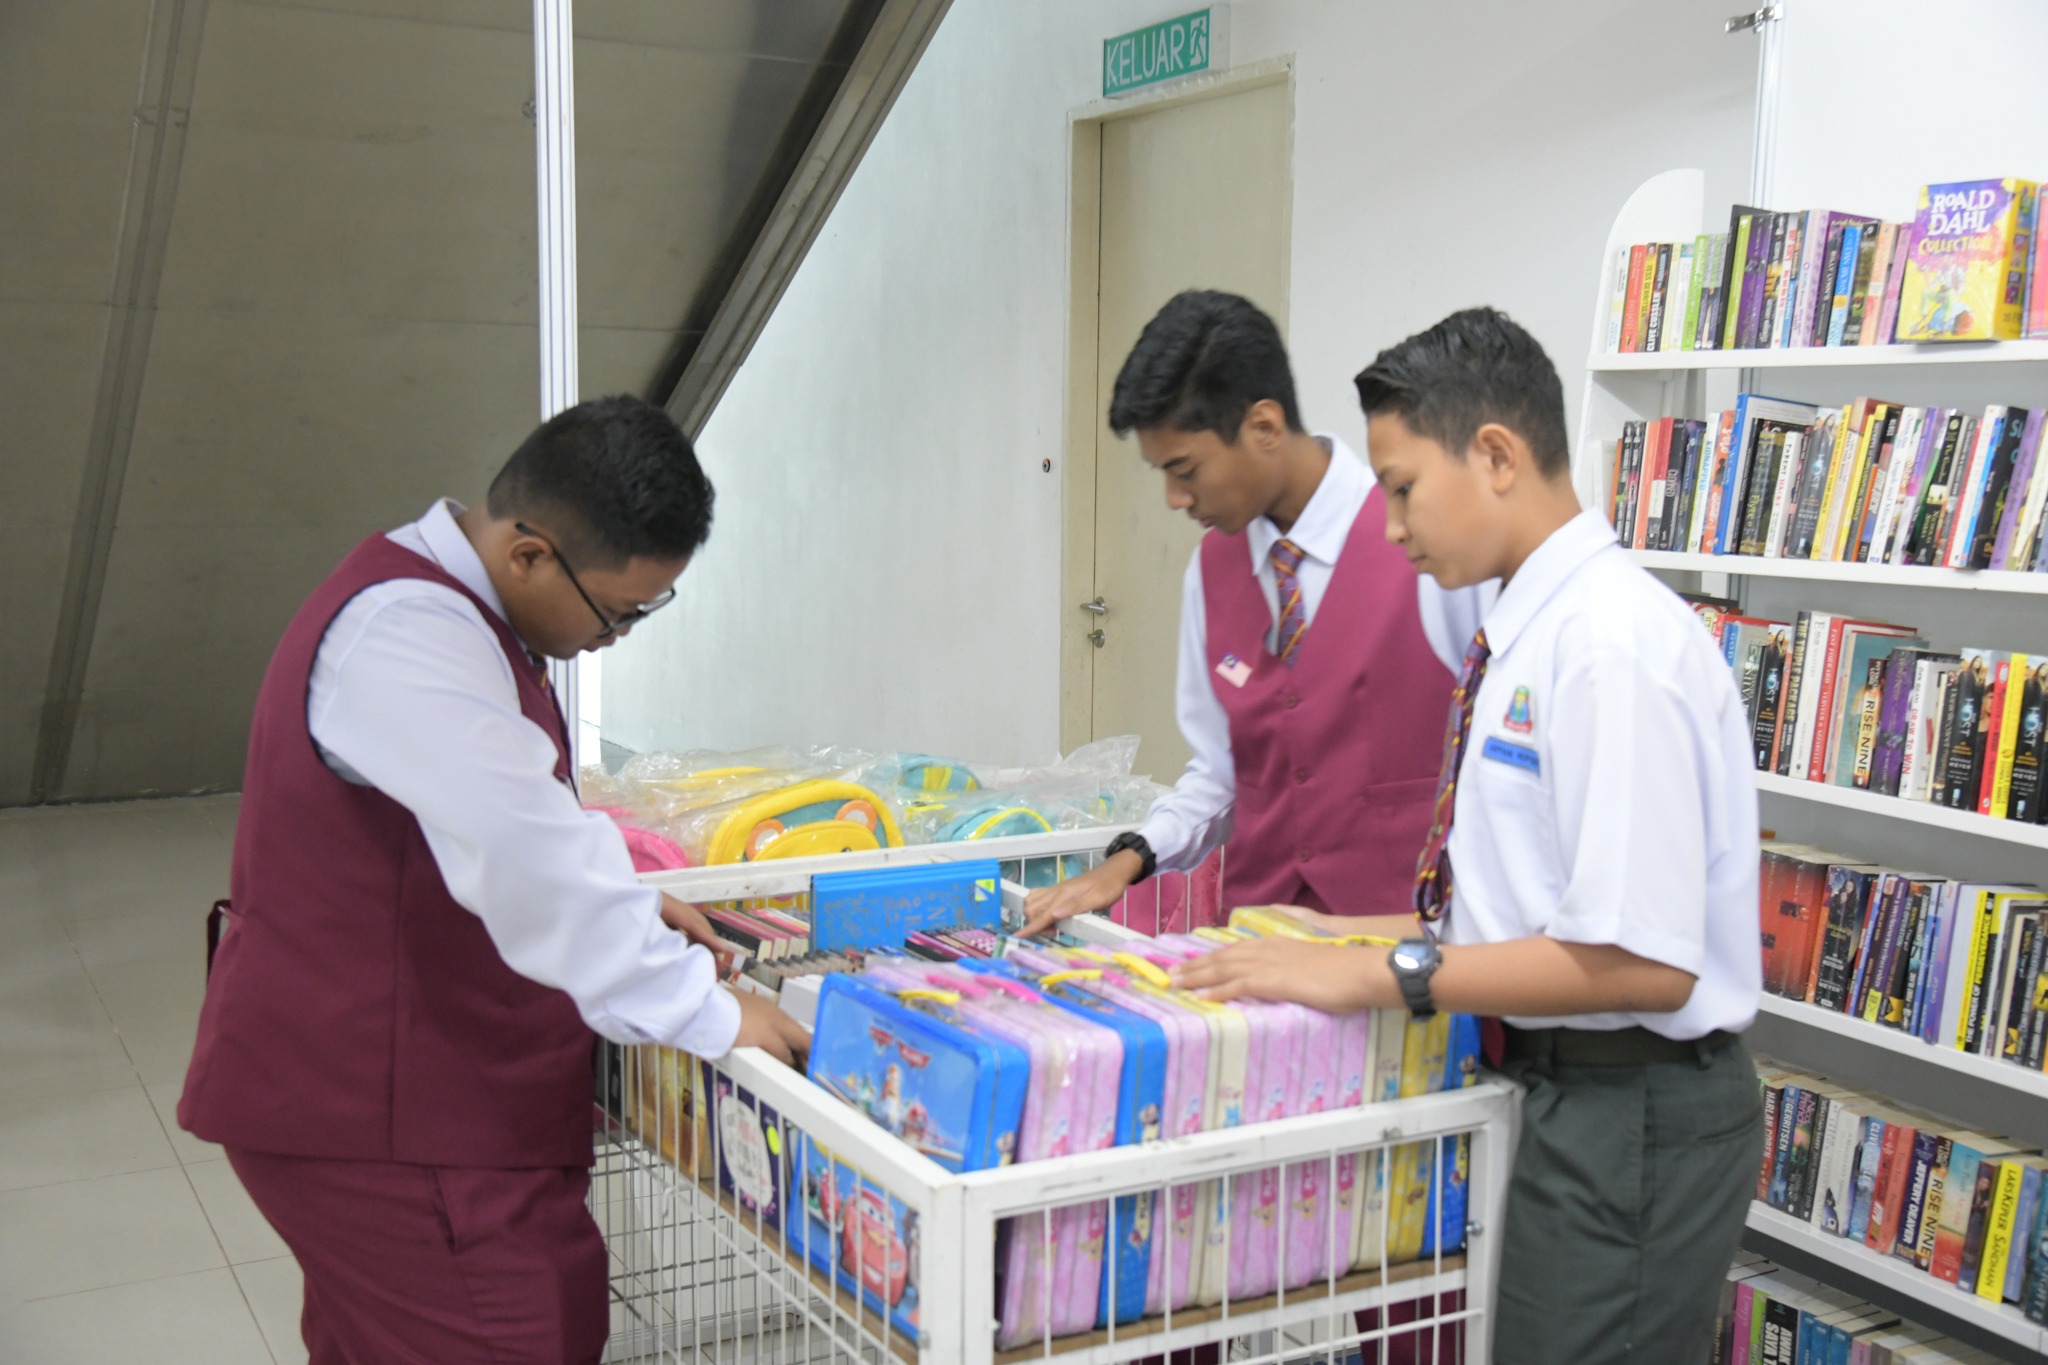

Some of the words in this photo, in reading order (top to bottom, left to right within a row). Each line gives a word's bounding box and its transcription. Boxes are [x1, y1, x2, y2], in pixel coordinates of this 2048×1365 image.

[1106, 23, 1185, 88] KELUAR
[1931, 190, 1995, 214] ROALD
[1928, 211, 1990, 235] DAHL
[1918, 235, 1992, 255] COLLECTION
[1650, 292, 1661, 327] CUSSLER
[1646, 327, 1657, 351] CLIVE
[1699, 441, 1712, 491] KIDNAPPED
[1781, 444, 1791, 475] PARENT
[1747, 495, 1759, 519] Flyte
[1797, 619, 1808, 638] THE
[1727, 633, 1736, 659] GOD
[1791, 640, 1805, 673] TRIPLE
[1824, 648, 1834, 684] FORWARD
[1915, 667, 1923, 681] DAN
[1765, 668, 1779, 703] HOST
[1784, 675, 1798, 722] PACKAGE
[1862, 700, 1875, 732] RISE
[1907, 708, 1918, 735] DRAW
[1959, 699, 1974, 736] HOST
[2023, 706, 2041, 747] HOST
[1857, 737, 1870, 774] NINE
[1904, 897, 1913, 912] SAS
[1895, 914, 1910, 947] OPERATION
[1974, 914, 1991, 984] PERSEVERANCE
[1818, 982, 1840, 993] MEYER
[1972, 985, 1981, 996] OF
[1968, 997, 1980, 1027] POWER
[1965, 1028, 1976, 1043] THE
[1765, 1091, 1776, 1125] HARLAN
[1797, 1091, 1810, 1127] French
[1817, 1100, 1827, 1131] SEBASTIAN
[1779, 1103, 1794, 1151] GERRITSEN
[1808, 1168, 1817, 1193] WITHOUT
[1910, 1160, 1927, 1203] JEFFERY
[1928, 1179, 1943, 1212] RISE
[2006, 1169, 2016, 1192] LARS
[1903, 1203, 1919, 1244] DEAVER
[1997, 1193, 2014, 1230] KEPLER
[1920, 1216, 1937, 1255] NINE
[1986, 1234, 2006, 1286] SANDMAN
[1764, 1322, 1779, 1356] SAYA
[1779, 1327, 1792, 1365] AWAK
